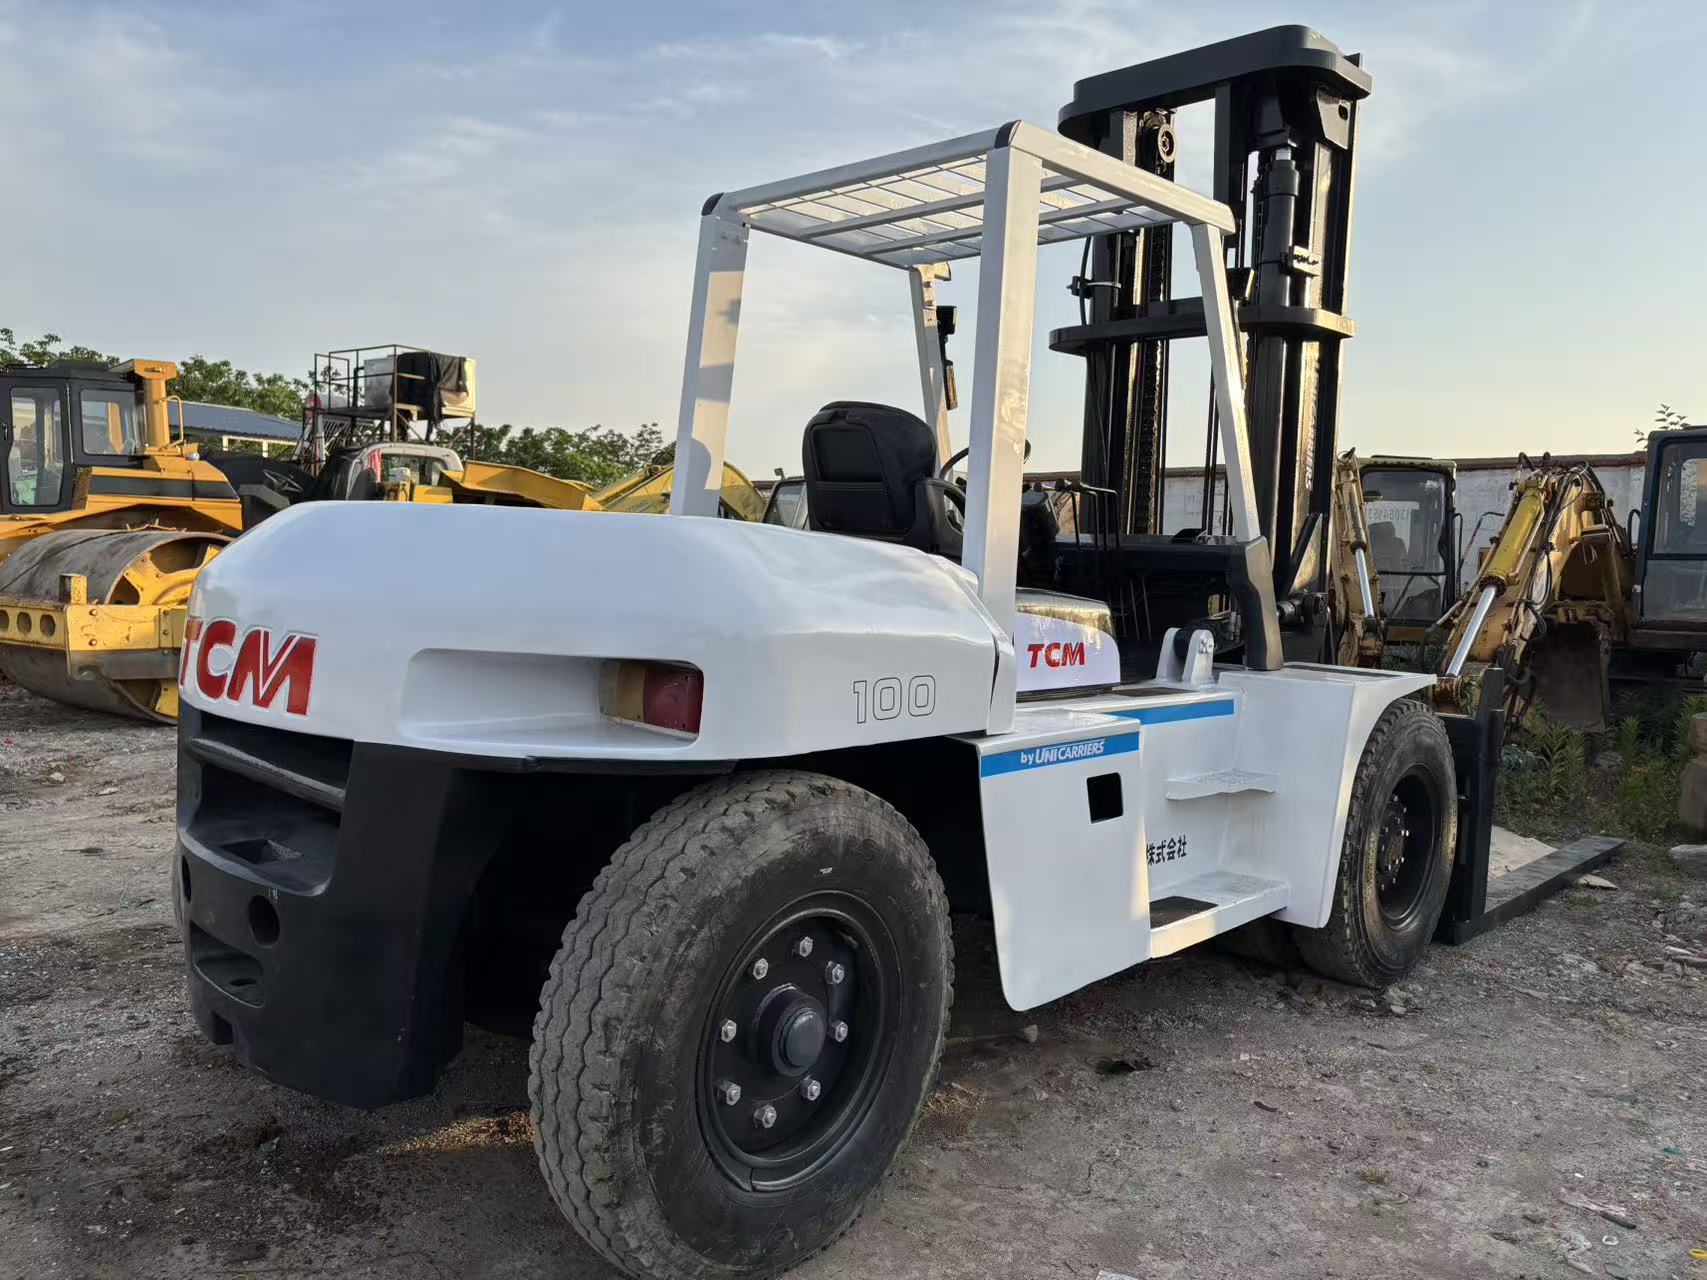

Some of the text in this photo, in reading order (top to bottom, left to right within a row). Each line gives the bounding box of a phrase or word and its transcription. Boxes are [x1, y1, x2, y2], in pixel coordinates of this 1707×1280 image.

[1027, 642, 1085, 668] TCM
[853, 675, 936, 724] 100
[1020, 752, 1034, 765] by
[1146, 835, 1187, 866] 株式会社
